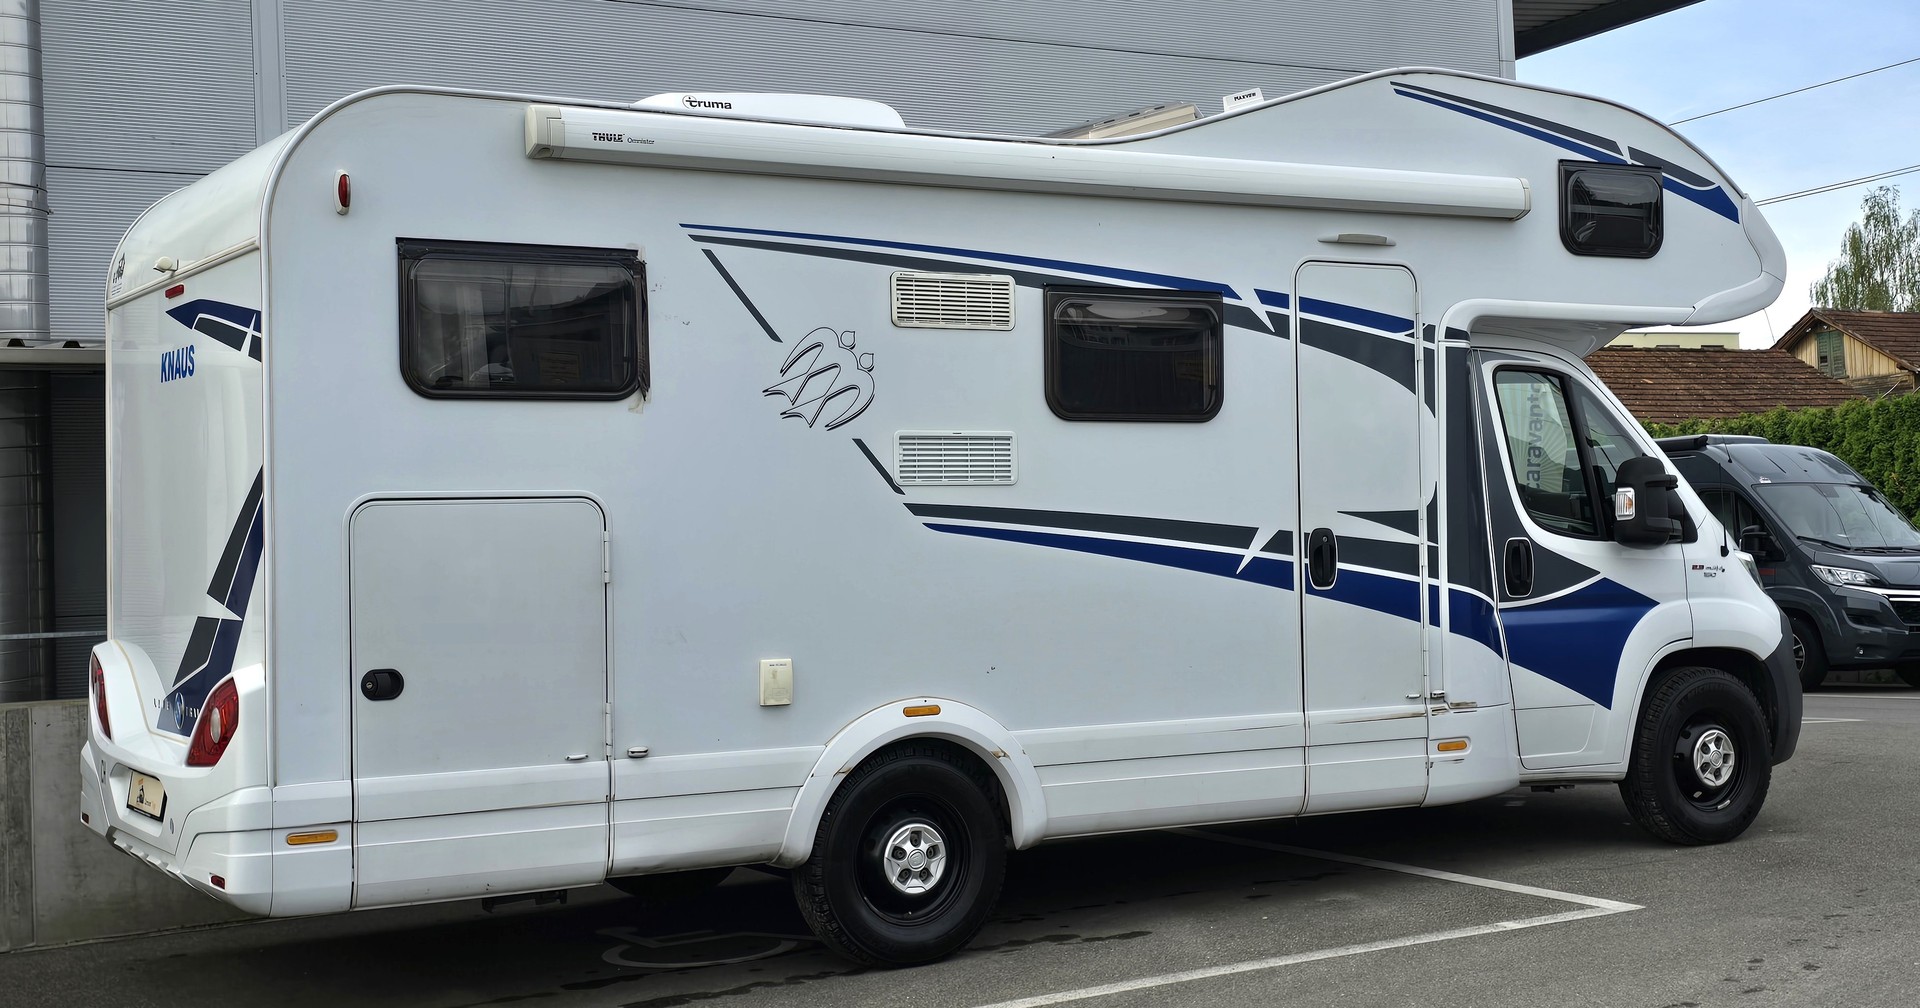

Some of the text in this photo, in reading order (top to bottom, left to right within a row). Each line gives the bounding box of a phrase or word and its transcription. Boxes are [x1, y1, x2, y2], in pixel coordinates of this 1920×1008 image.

[684, 96, 732, 109] truma
[592, 132, 623, 142] THULE
[160, 344, 195, 383] KNAUS
